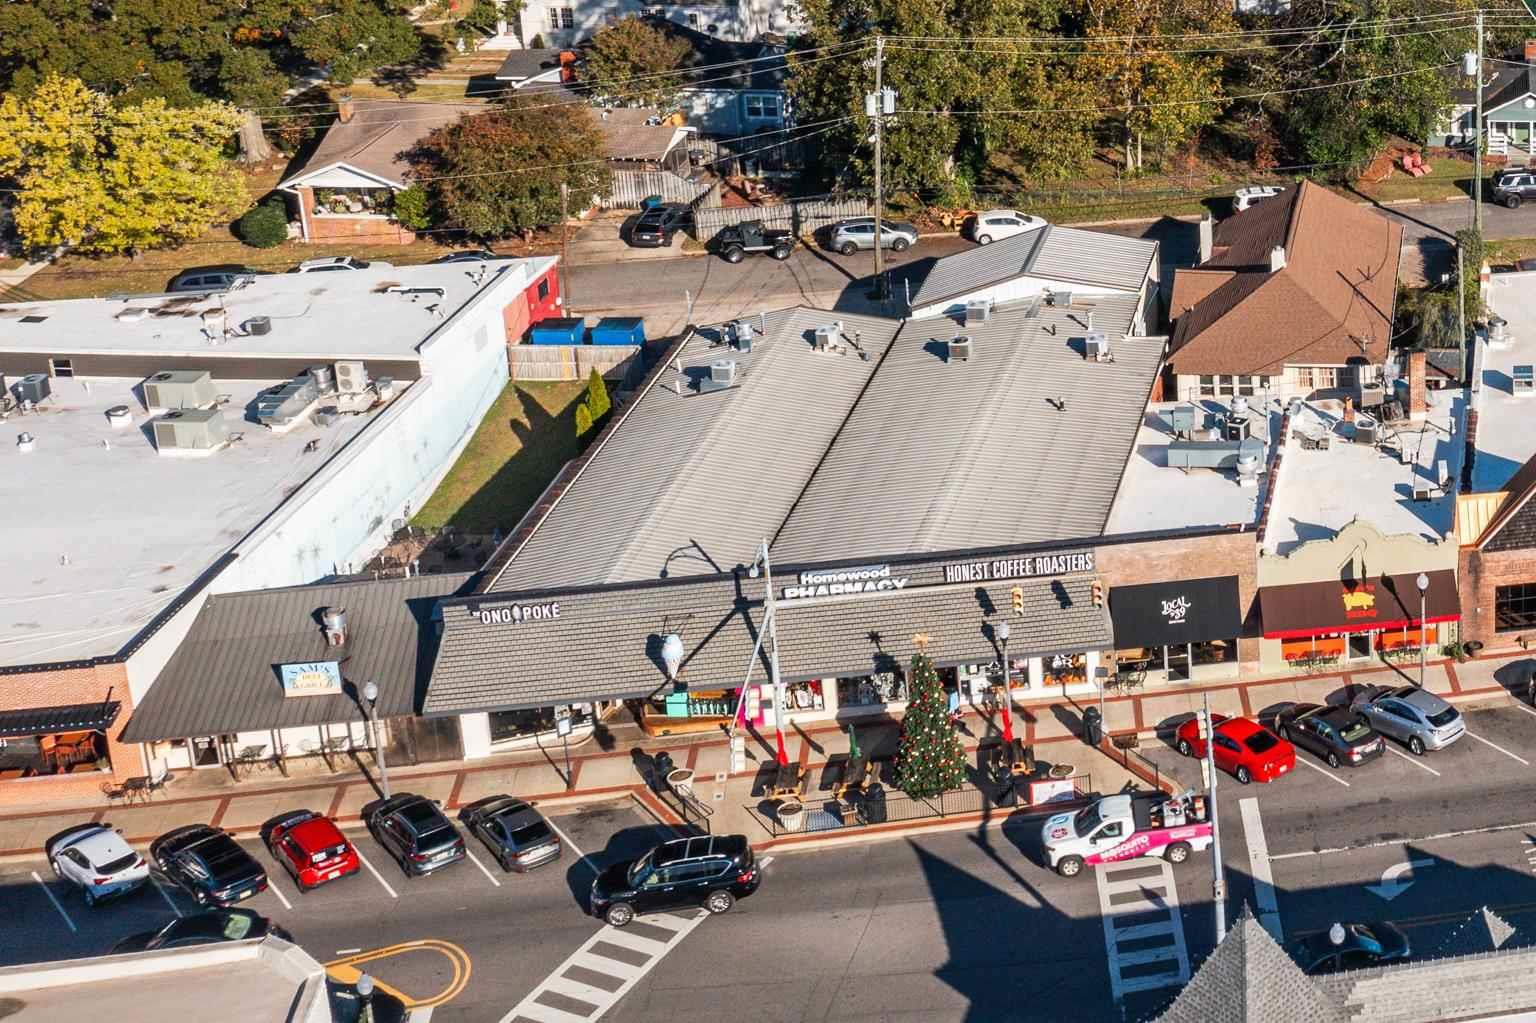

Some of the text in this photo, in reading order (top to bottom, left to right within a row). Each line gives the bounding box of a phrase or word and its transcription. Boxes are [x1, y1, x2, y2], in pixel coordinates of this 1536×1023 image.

[801, 566, 890, 585] Homewood
[946, 553, 1093, 582] HONEST COFFEE ROASTERS
[784, 578, 909, 598] PHARMACY
